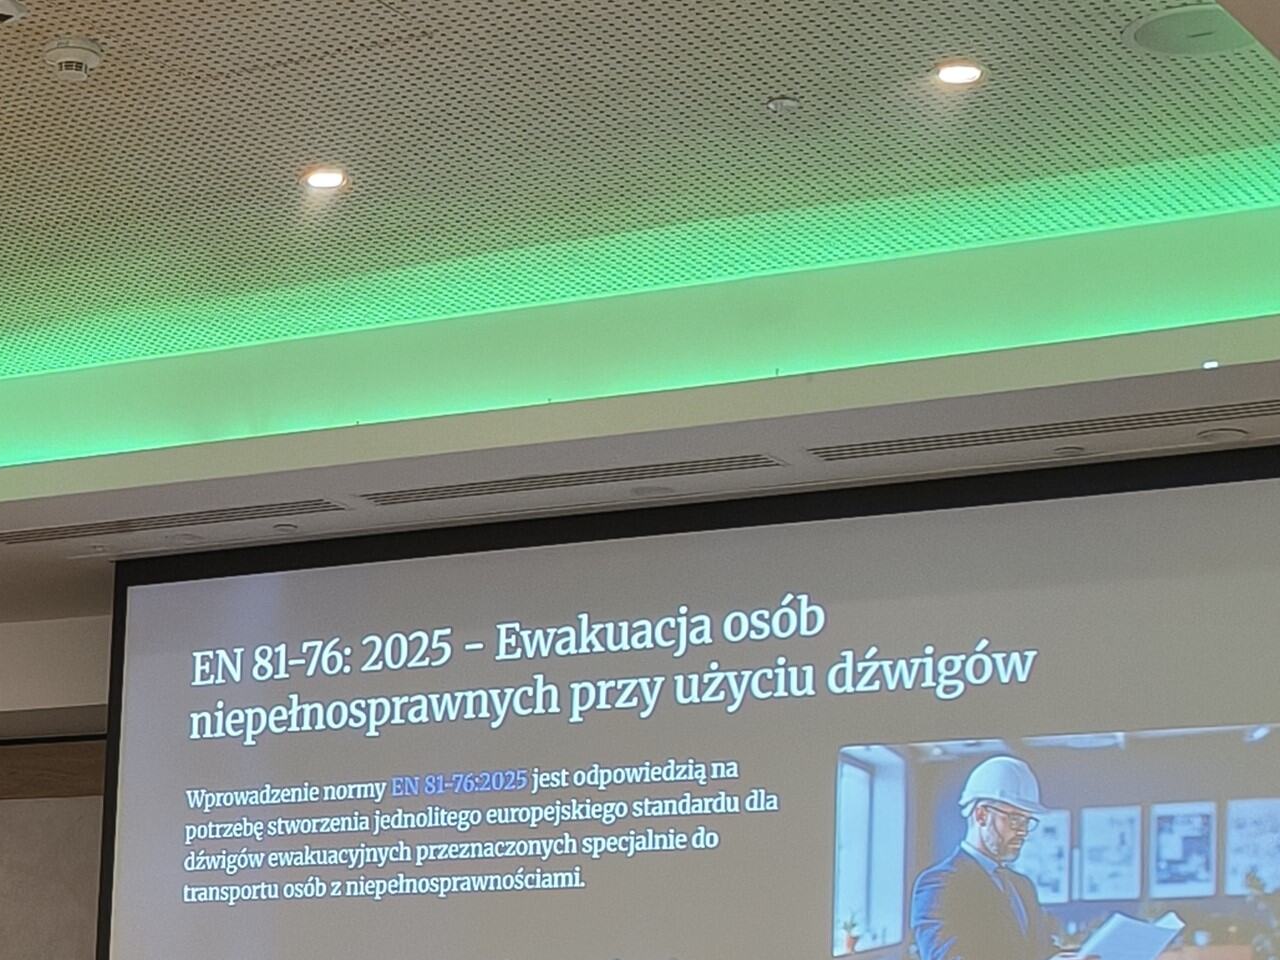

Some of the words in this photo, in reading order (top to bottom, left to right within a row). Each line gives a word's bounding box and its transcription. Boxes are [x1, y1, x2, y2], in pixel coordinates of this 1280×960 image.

[191, 647, 245, 686] EN
[251, 637, 352, 682] 81-76:
[361, 627, 452, 673] 2025
[495, 604, 713, 661] Ewakuacja
[722, 592, 825, 643] osób
[189, 673, 561, 746] niepełnosprawnych
[569, 675, 665, 723] przy
[673, 656, 816, 714] użyciu
[827, 637, 1038, 701] dźwigów
[185, 782, 319, 812] Wprowadzenie
[322, 782, 387, 804] normy
[391, 776, 420, 797] EN
[424, 769, 528, 795] 81-76:2025
[530, 768, 570, 794] jest
[573, 759, 707, 790] odpowiedzią
[710, 759, 739, 780] na
[184, 816, 263, 845] potrzebę
[266, 810, 370, 837] stworzenia
[372, 805, 483, 836] jednolitego
[486, 798, 628, 828] europejskiego
[631, 792, 740, 819] standardu
[744, 788, 779, 813] dla
[183, 849, 264, 875] dźwigów
[267, 840, 412, 869] ewakuacyjnych
[415, 832, 577, 867] przeznaczonych
[581, 828, 688, 859] specjalnie
[691, 826, 720, 850] do
[183, 883, 279, 907] transportu
[283, 875, 326, 900] osób
[330, 881, 342, 897] z
[345, 867, 586, 900] niepełnosprawnościami.
